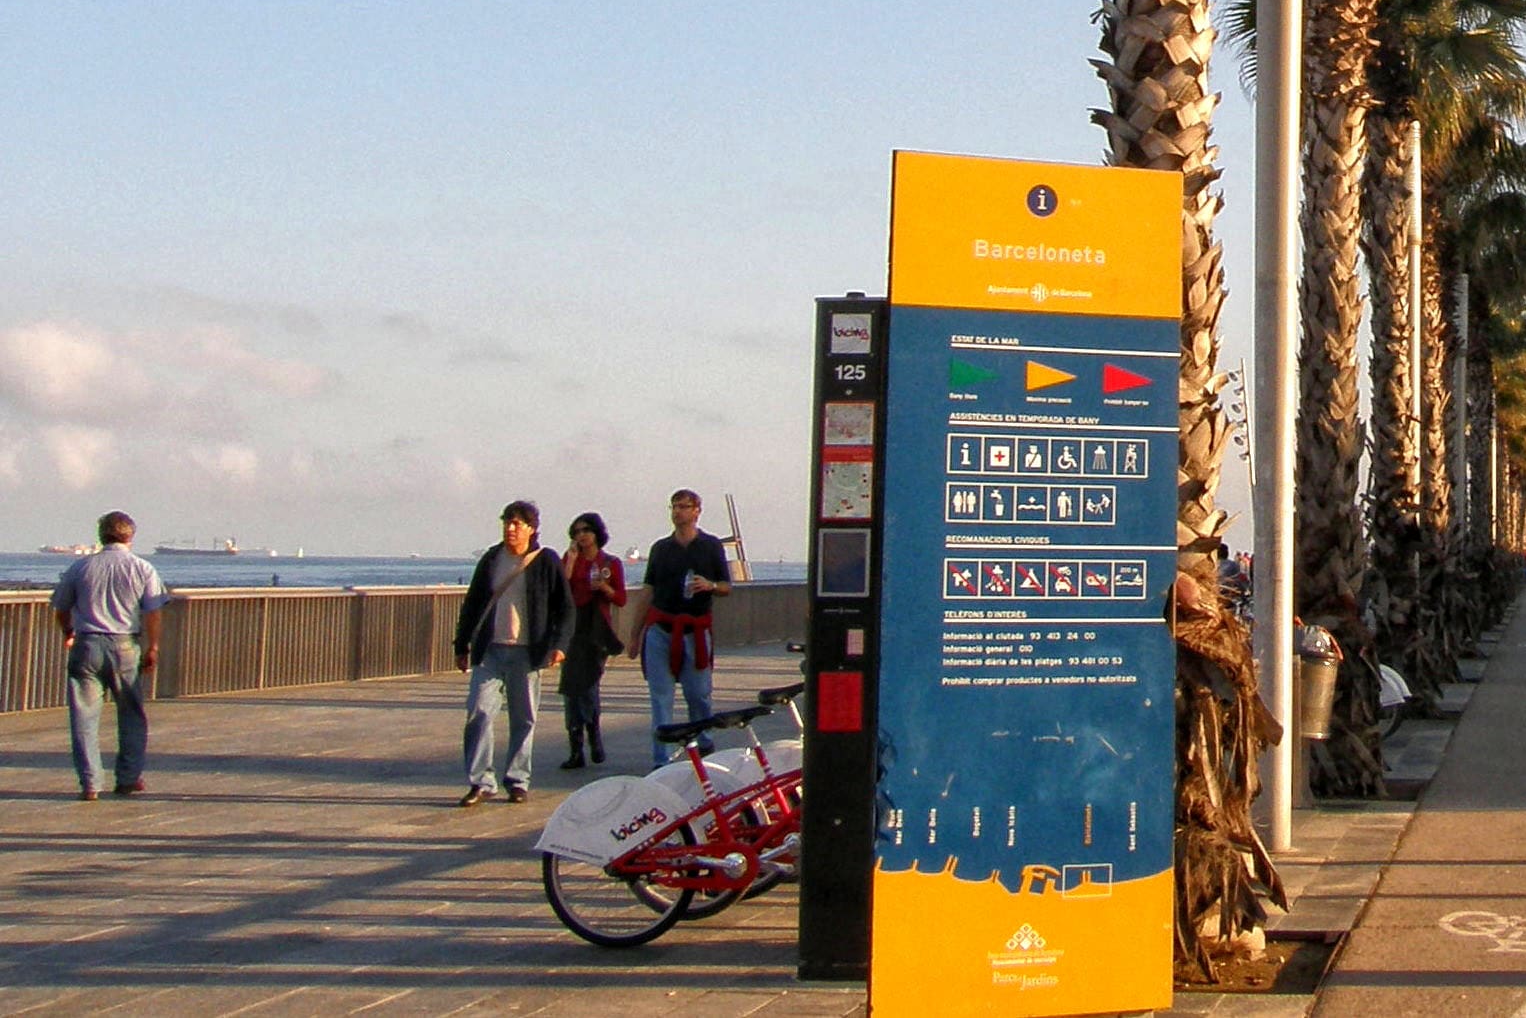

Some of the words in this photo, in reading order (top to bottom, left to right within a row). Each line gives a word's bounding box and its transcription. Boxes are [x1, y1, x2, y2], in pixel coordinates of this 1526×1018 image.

[973, 238, 1106, 264] Barceloneta
[951, 335, 974, 343] ESTAT
[975, 336, 986, 344] DE
[1001, 338, 1020, 346] MAR
[834, 364, 866, 381] 125
[1018, 415, 1064, 424] TEMPORADA
[1078, 417, 1100, 425] BANY
[945, 535, 1013, 544] RECOMANACIONS
[986, 632, 993, 640] al
[1030, 632, 1041, 640] 93
[1046, 632, 1061, 640] 413
[1066, 632, 1079, 640] 24
[1084, 632, 1096, 640] 00
[985, 645, 1013, 654] general
[1019, 645, 1034, 653] 010
[1008, 658, 1018, 666] de
[1020, 658, 1032, 666] les
[1035, 658, 1062, 667] platges
[1068, 657, 1080, 665] 93
[1098, 657, 1110, 665] 00
[1111, 657, 1123, 665] 53
[942, 677, 971, 685] Prohibit
[973, 678, 1005, 686] comprar
[1006, 676, 1042, 685] productes
[1051, 676, 1085, 684] venedors
[1086, 676, 1097, 684] no
[1098, 675, 1137, 683] autoritzats
[609, 807, 668, 841] bicing
